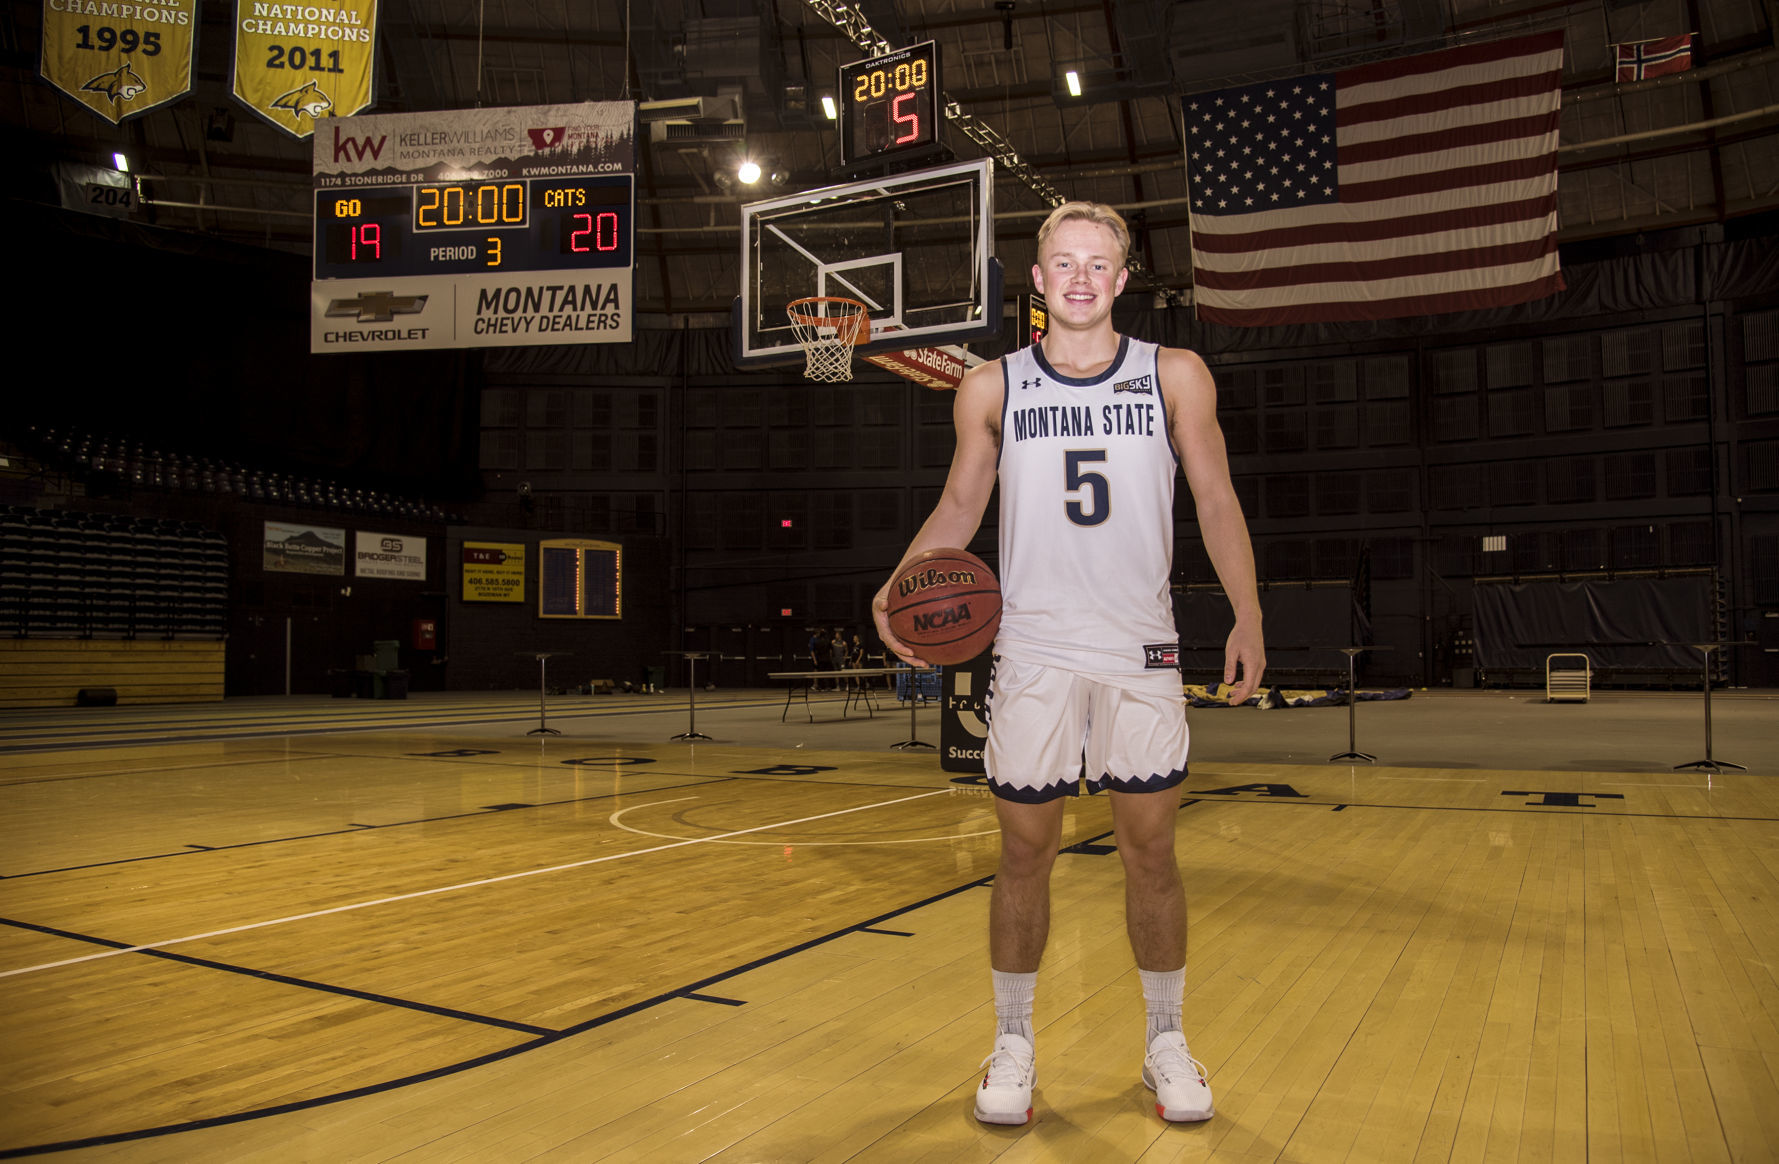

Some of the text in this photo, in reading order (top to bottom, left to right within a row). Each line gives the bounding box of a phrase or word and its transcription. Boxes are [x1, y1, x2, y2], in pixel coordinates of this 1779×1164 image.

[50, 0, 189, 26] CHAMPIONS
[253, 2, 361, 25] NATIONAL
[76, 25, 162, 57] 1995
[242, 19, 370, 43] CHAMPIONS
[266, 45, 344, 74] 2011
[865, 51, 911, 69] DAKTRONICS
[855, 59, 927, 102] 20:00
[892, 92, 919, 145] 5
[400, 144, 516, 160] MONTANA REALTY
[320, 177, 342, 187] 1174
[345, 174, 407, 186] STONERIDGE
[410, 173, 424, 182] DR
[522, 162, 622, 177] KWMONTANA.COM
[91, 186, 131, 208] 204
[335, 199, 361, 218] GO
[418, 184, 523, 226] 20:00
[544, 188, 586, 207] CATS
[351, 223, 380, 260] 19
[571, 212, 618, 252] 20
[430, 246, 477, 261] PERIOD
[486, 237, 501, 266] 3
[476, 283, 621, 316] MONTANA
[323, 327, 430, 343] CHEVROLET
[473, 312, 621, 335] CHEVY DEALERS
[1013, 403, 1154, 442] MONTANA STATE
[1062, 448, 1112, 528] 5
[899, 568, 977, 598] Wilson
[913, 604, 972, 632] NCAA
